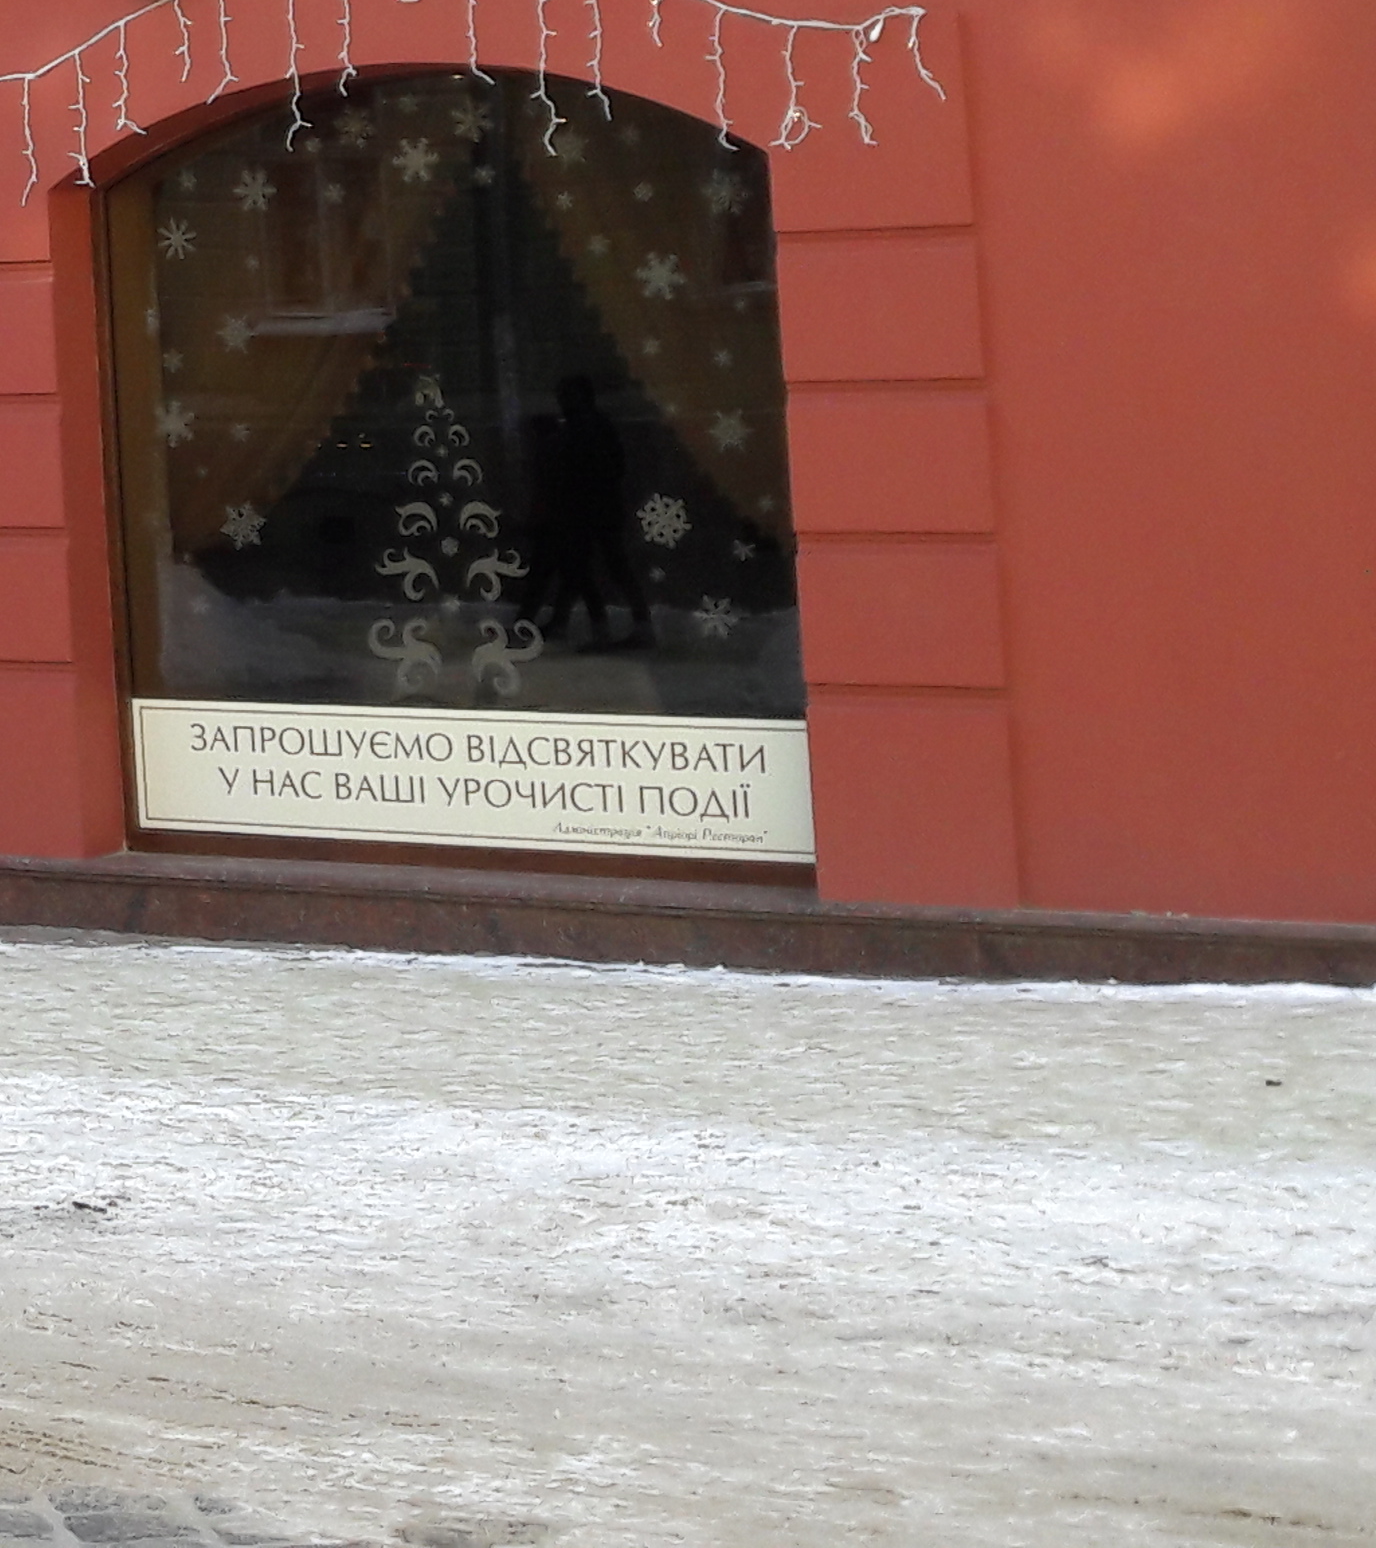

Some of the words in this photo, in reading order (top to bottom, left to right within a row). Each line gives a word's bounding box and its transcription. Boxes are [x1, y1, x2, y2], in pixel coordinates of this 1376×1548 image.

[189, 722, 454, 762] ЗАПРОШУЄМО
[465, 733, 767, 774] ВІДСВЯТКУВАТИ
[217, 766, 240, 795] У
[251, 768, 323, 800] НАС
[334, 772, 426, 804] ВАШІ
[436, 776, 625, 814] УРОЧИСТІ
[638, 782, 752, 824] ПОДІЇ
